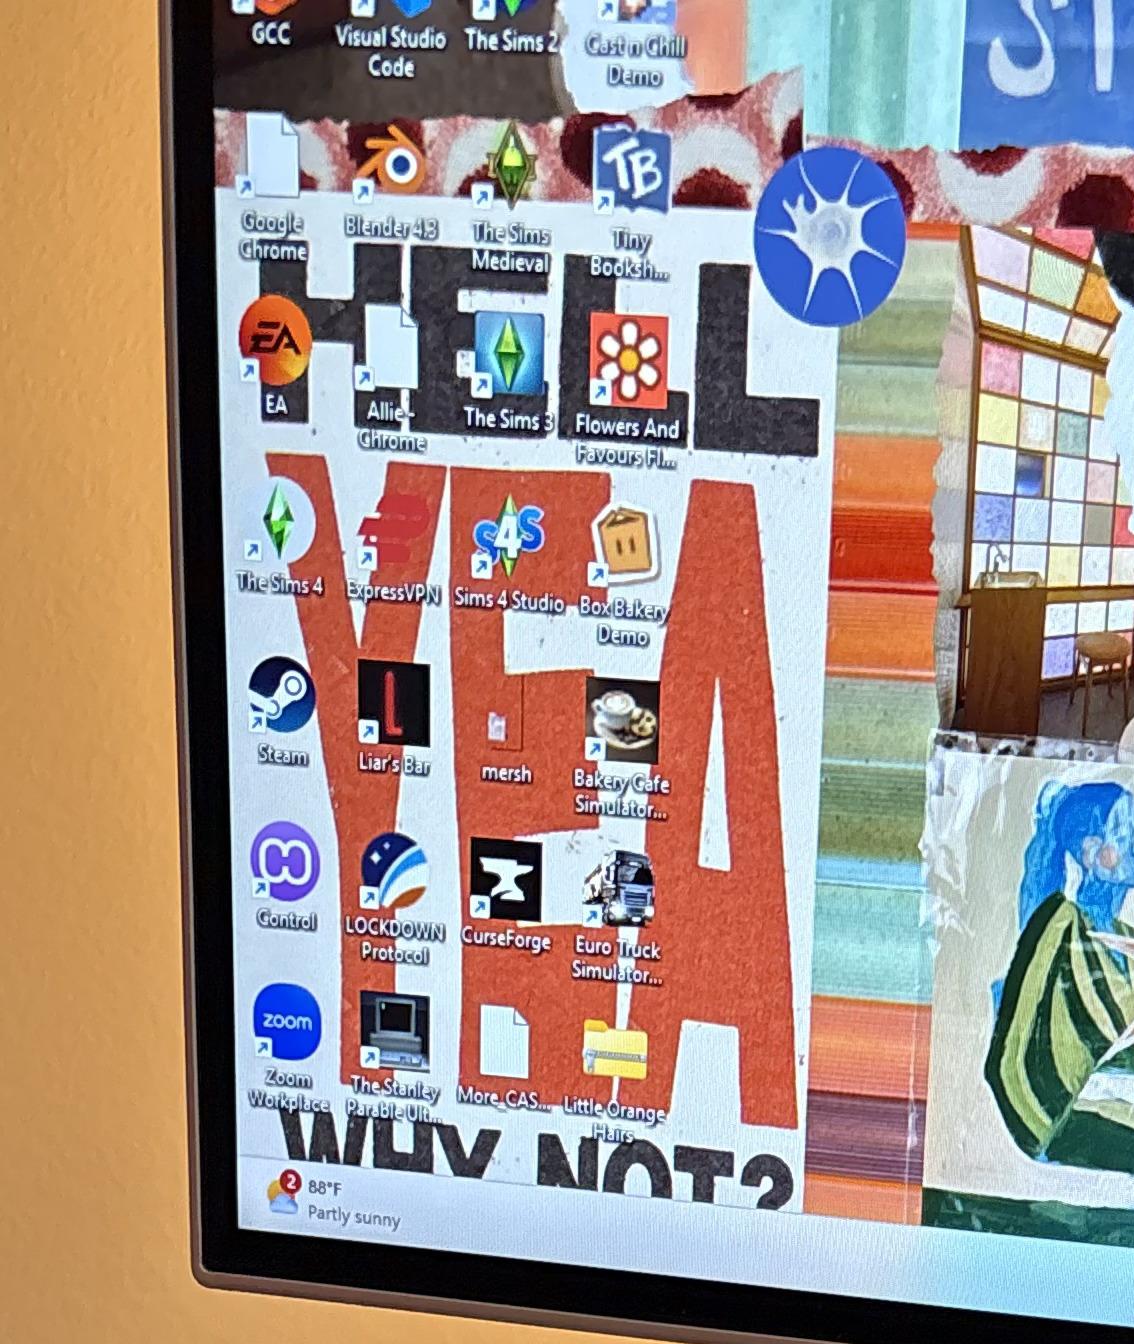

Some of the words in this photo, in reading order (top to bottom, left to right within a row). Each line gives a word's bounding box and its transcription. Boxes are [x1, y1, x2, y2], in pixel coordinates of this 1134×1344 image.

[252, 20, 291, 45] GCC
[336, 24, 386, 48] Visual
[390, 24, 446, 50] Studio
[464, 27, 498, 51] The
[502, 28, 543, 52] Sims
[547, 30, 560, 53] 2
[585, 33, 626, 57] Cast
[628, 40, 641, 57] n
[646, 33, 687, 58] Chill
[369, 54, 415, 78] Code
[607, 64, 663, 87] Demo
[242, 210, 304, 238] Google
[345, 215, 410, 238] Blender
[412, 219, 439, 239] 4.3
[473, 221, 505, 243] The
[508, 222, 551, 245] Sims
[239, 239, 308, 261] Chrome
[612, 228, 653, 252] Tiny
[471, 250, 549, 273] Medieval
[265, 394, 289, 415] EA
[367, 401, 406, 421] Allie
[463, 406, 497, 428] The
[499, 407, 540, 431] Sims
[544, 411, 556, 432] 3
[575, 413, 640, 437] Flowers
[643, 418, 680, 440] And
[358, 428, 427, 451] Chrome
[575, 443, 642, 466] Favours
[236, 571, 268, 592] The
[270, 572, 309, 594] Sims
[312, 576, 324, 595] 4
[347, 579, 442, 605] ExpressVPN
[454, 587, 493, 608] Sims
[496, 590, 508, 609] 4
[512, 590, 565, 614] Studio
[580, 597, 611, 617] Box
[614, 599, 668, 625] Bakery
[598, 624, 649, 646] Demo
[258, 744, 309, 766] Steam
[359, 752, 400, 774] Liar's
[402, 754, 431, 776] Bar
[481, 764, 532, 784] mersh
[573, 769, 629, 794] Bakery
[632, 772, 671, 795] Cafe
[257, 908, 318, 931] Control
[346, 916, 446, 942] LOCKDOWN
[462, 926, 552, 953] CurseForge
[575, 935, 612, 956] Euro
[616, 938, 661, 960] Truck
[361, 941, 430, 965] Protocol
[263, 1013, 313, 1031] zoom
[265, 1069, 312, 1089] Zoom
[351, 1075, 382, 1093] The
[384, 1078, 441, 1106] Stanley
[249, 1090, 330, 1114] Workplace
[346, 1101, 404, 1121] Parable
[564, 1096, 602, 1116] Little
[606, 1099, 666, 1125] Orange
[592, 1124, 635, 1143] Hairs
[308, 1180, 342, 1196] 88°F
[308, 1204, 350, 1226] Partly
[355, 1212, 401, 1231] sunny
